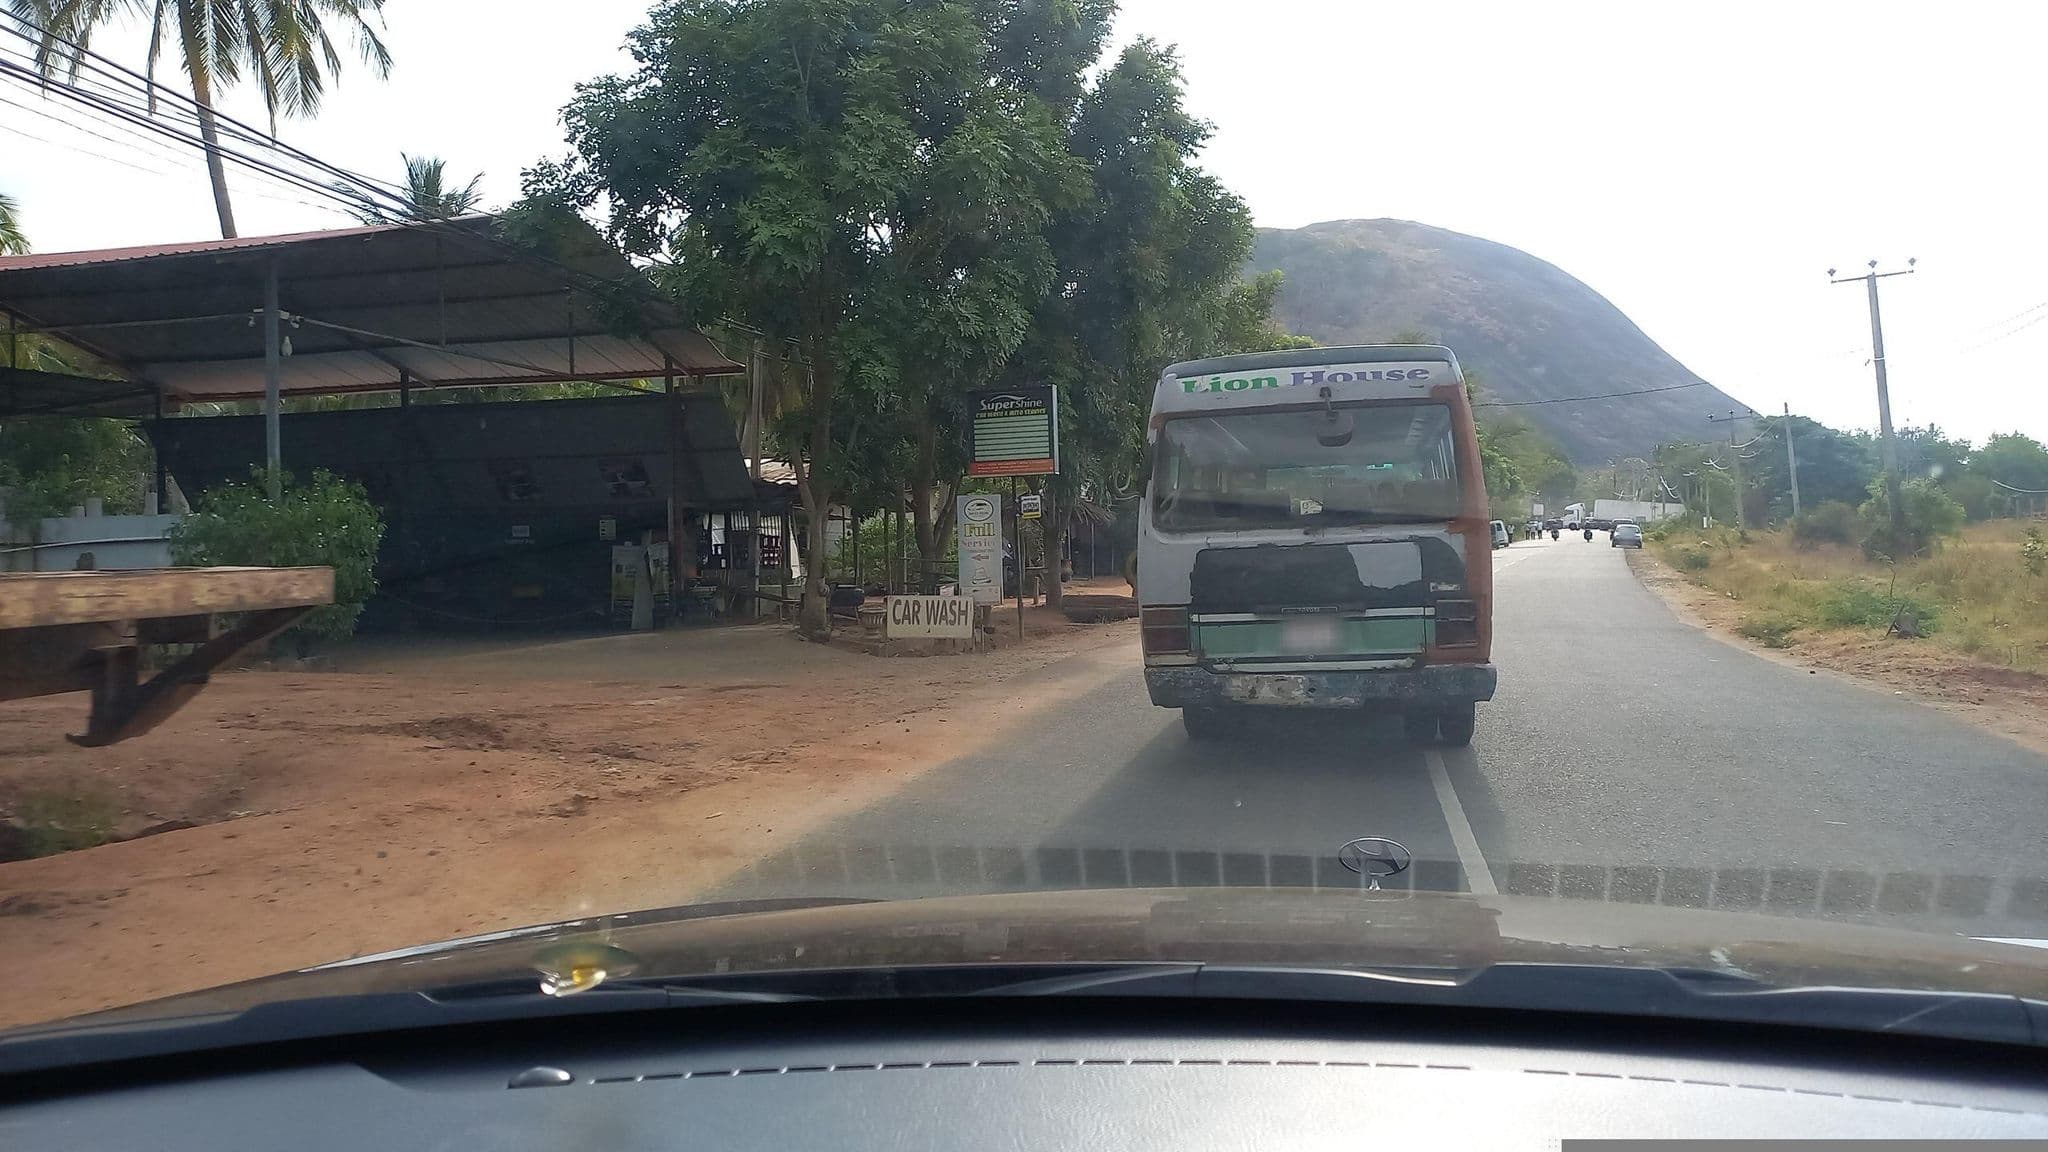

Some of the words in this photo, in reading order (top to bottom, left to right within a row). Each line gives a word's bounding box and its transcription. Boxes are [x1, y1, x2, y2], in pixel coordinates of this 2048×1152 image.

[1182, 375, 1279, 394] Lion
[1290, 367, 1429, 387] House
[964, 523, 995, 537] Full
[892, 599, 921, 625] CAR
[925, 599, 969, 626] WASH
